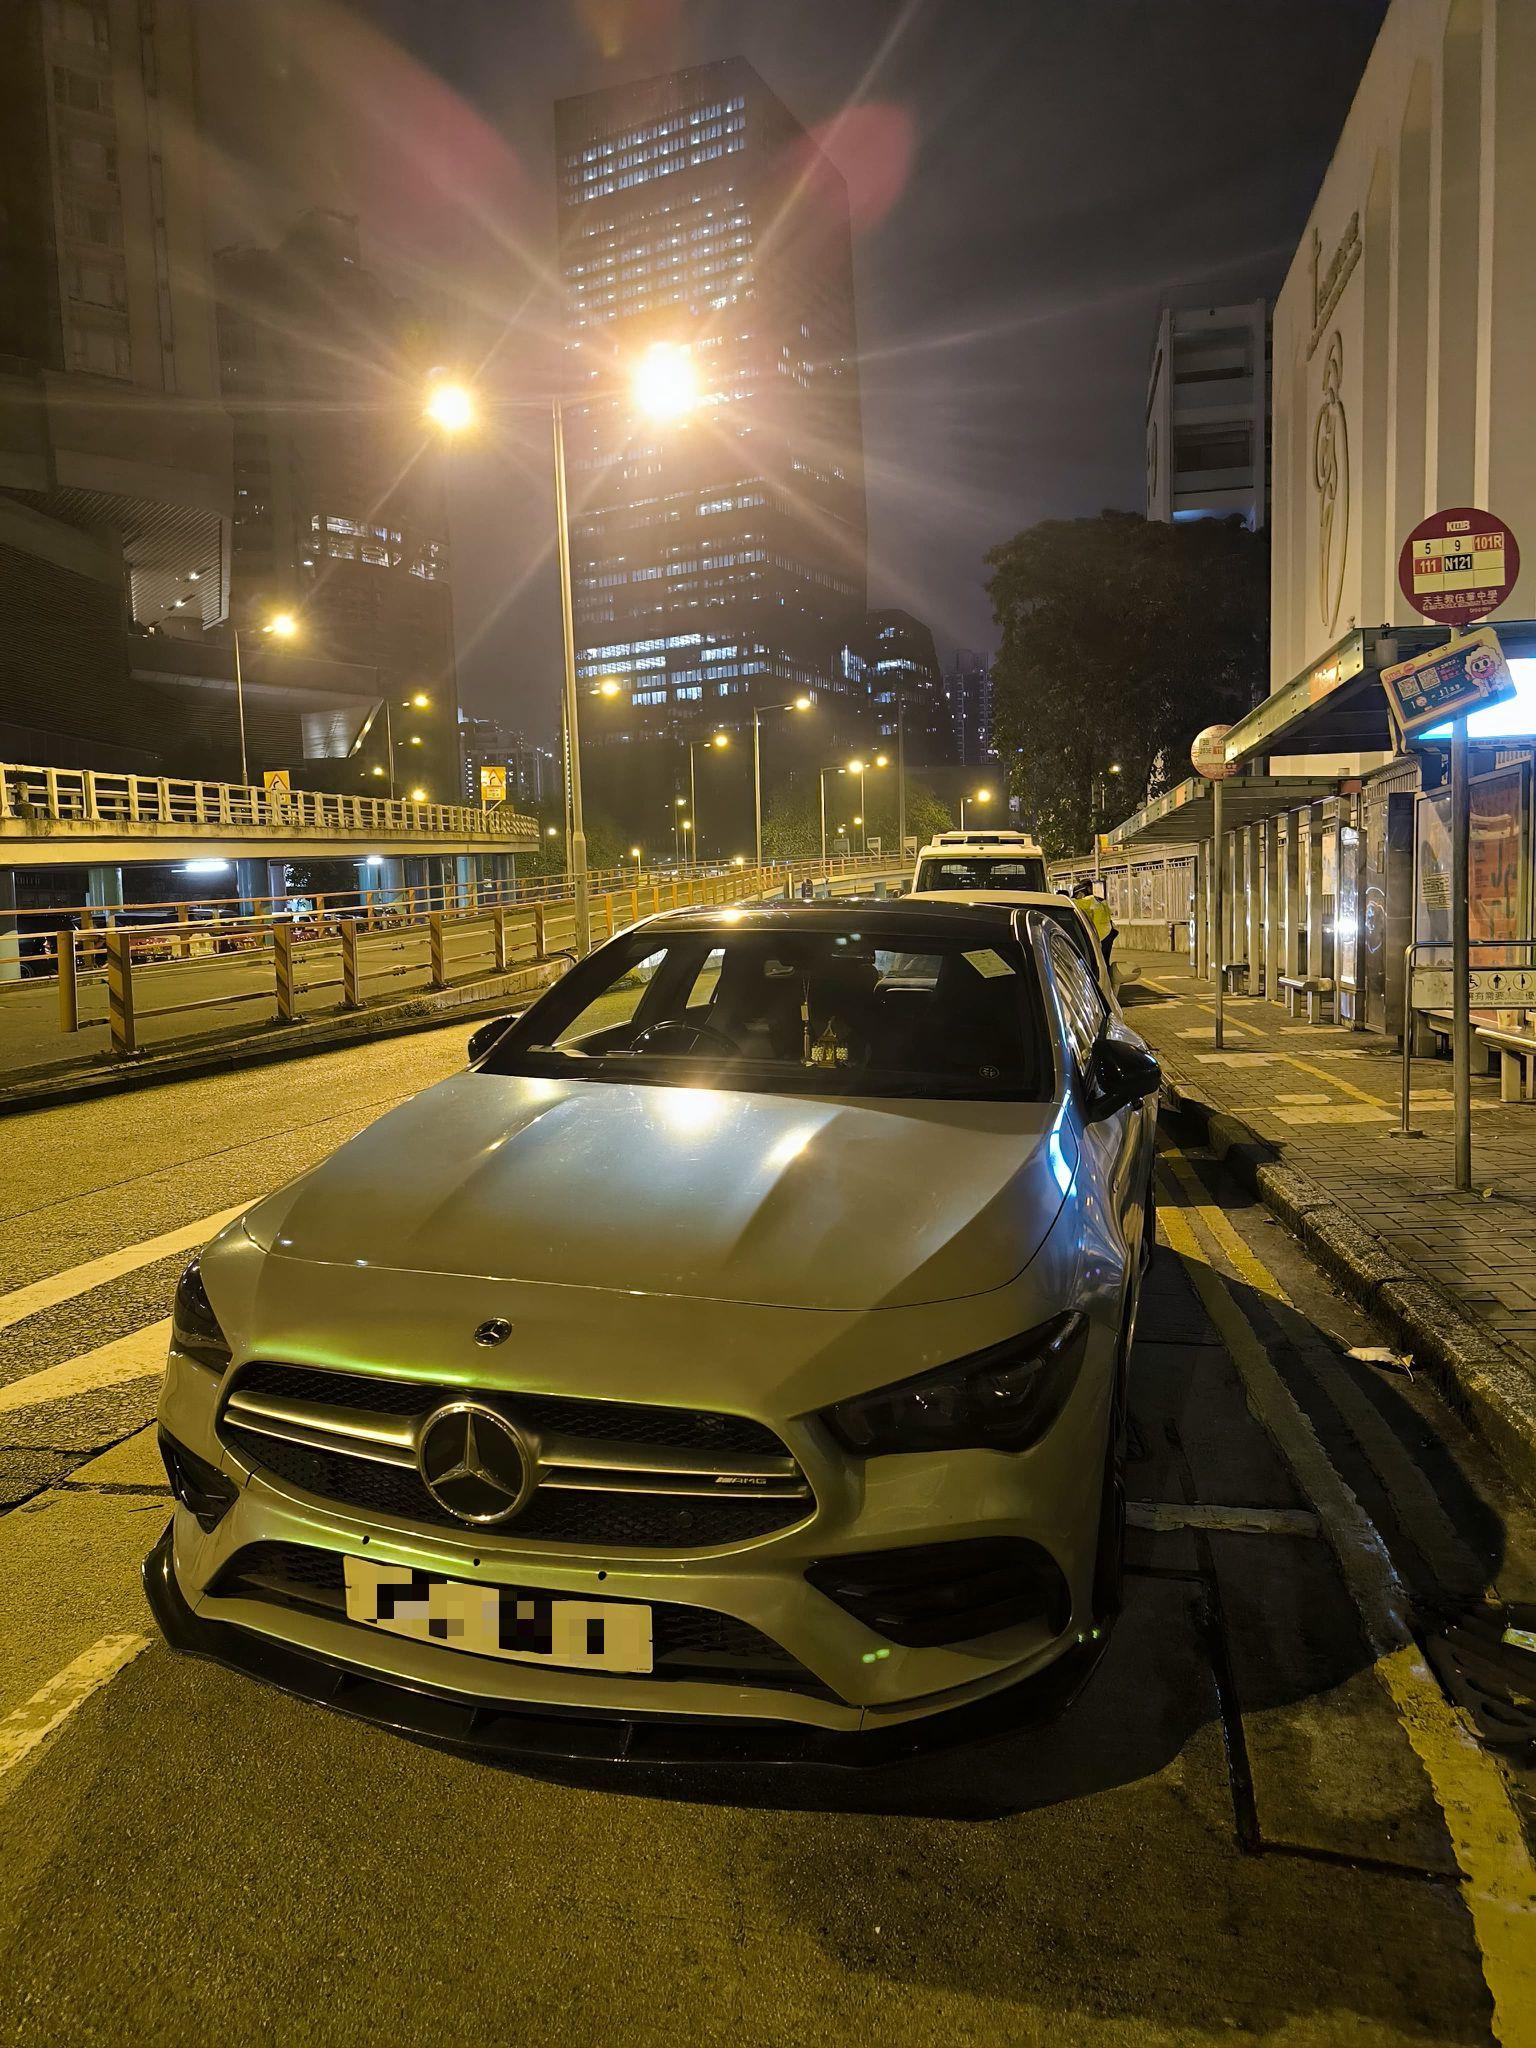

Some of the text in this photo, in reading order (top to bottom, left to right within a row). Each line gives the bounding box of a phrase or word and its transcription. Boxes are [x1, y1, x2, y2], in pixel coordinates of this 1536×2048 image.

[1446, 520, 1471, 532] KMB
[1425, 535, 1503, 554] 5 9 101R
[1420, 555, 1472, 573] 111 N121
[731, 1477, 767, 1485] AMG
